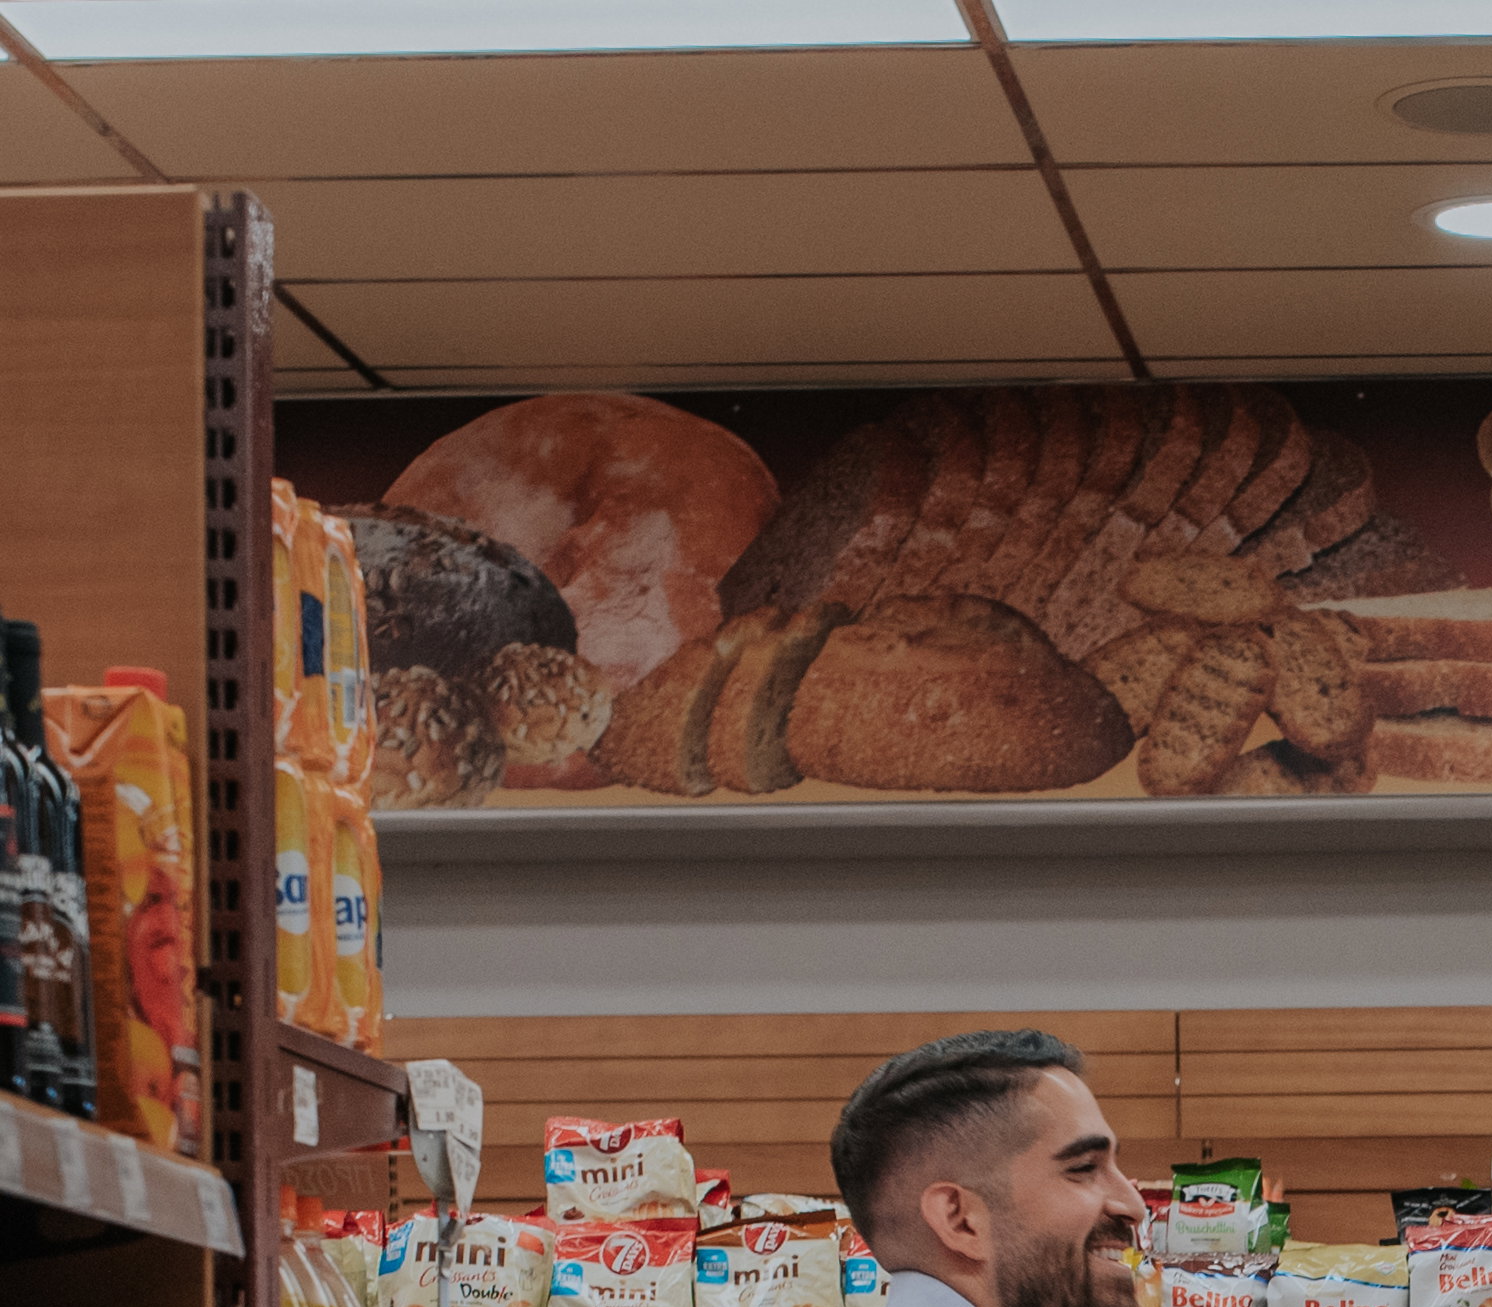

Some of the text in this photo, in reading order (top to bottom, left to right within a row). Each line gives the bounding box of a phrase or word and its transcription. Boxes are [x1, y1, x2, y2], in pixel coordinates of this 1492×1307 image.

[580, 1152, 645, 1185] mini
[608, 1237, 634, 1273] 7
[459, 1283, 513, 1304] Double
[588, 1279, 657, 1305] mini
